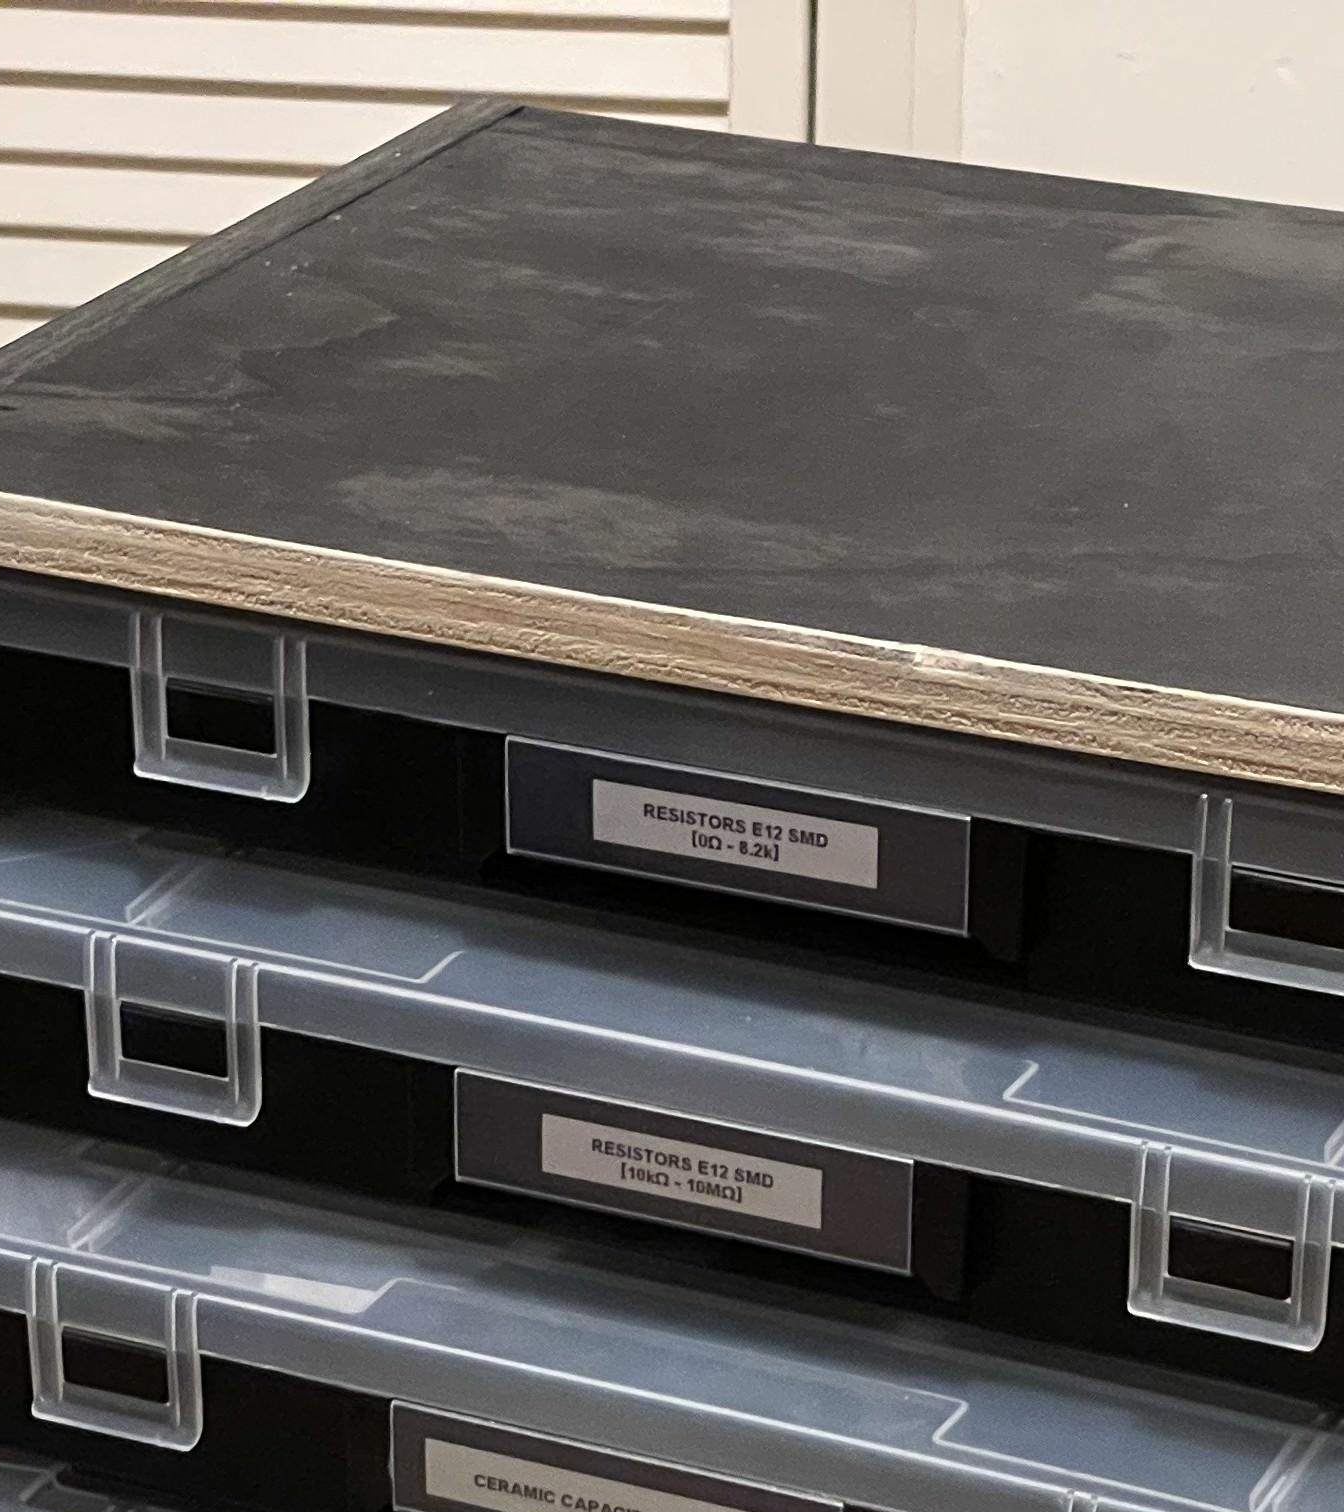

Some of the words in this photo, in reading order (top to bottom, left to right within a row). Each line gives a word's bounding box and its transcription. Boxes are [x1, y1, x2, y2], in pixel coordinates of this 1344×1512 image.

[644, 803, 746, 833] RESISTORS
[752, 822, 782, 841] E12
[788, 828, 828, 848] SMD
[592, 1138, 692, 1172] RESISTORS
[698, 1161, 729, 1180] E12
[734, 1168, 774, 1188] SMD
[474, 1473, 556, 1505] CERAMIC
